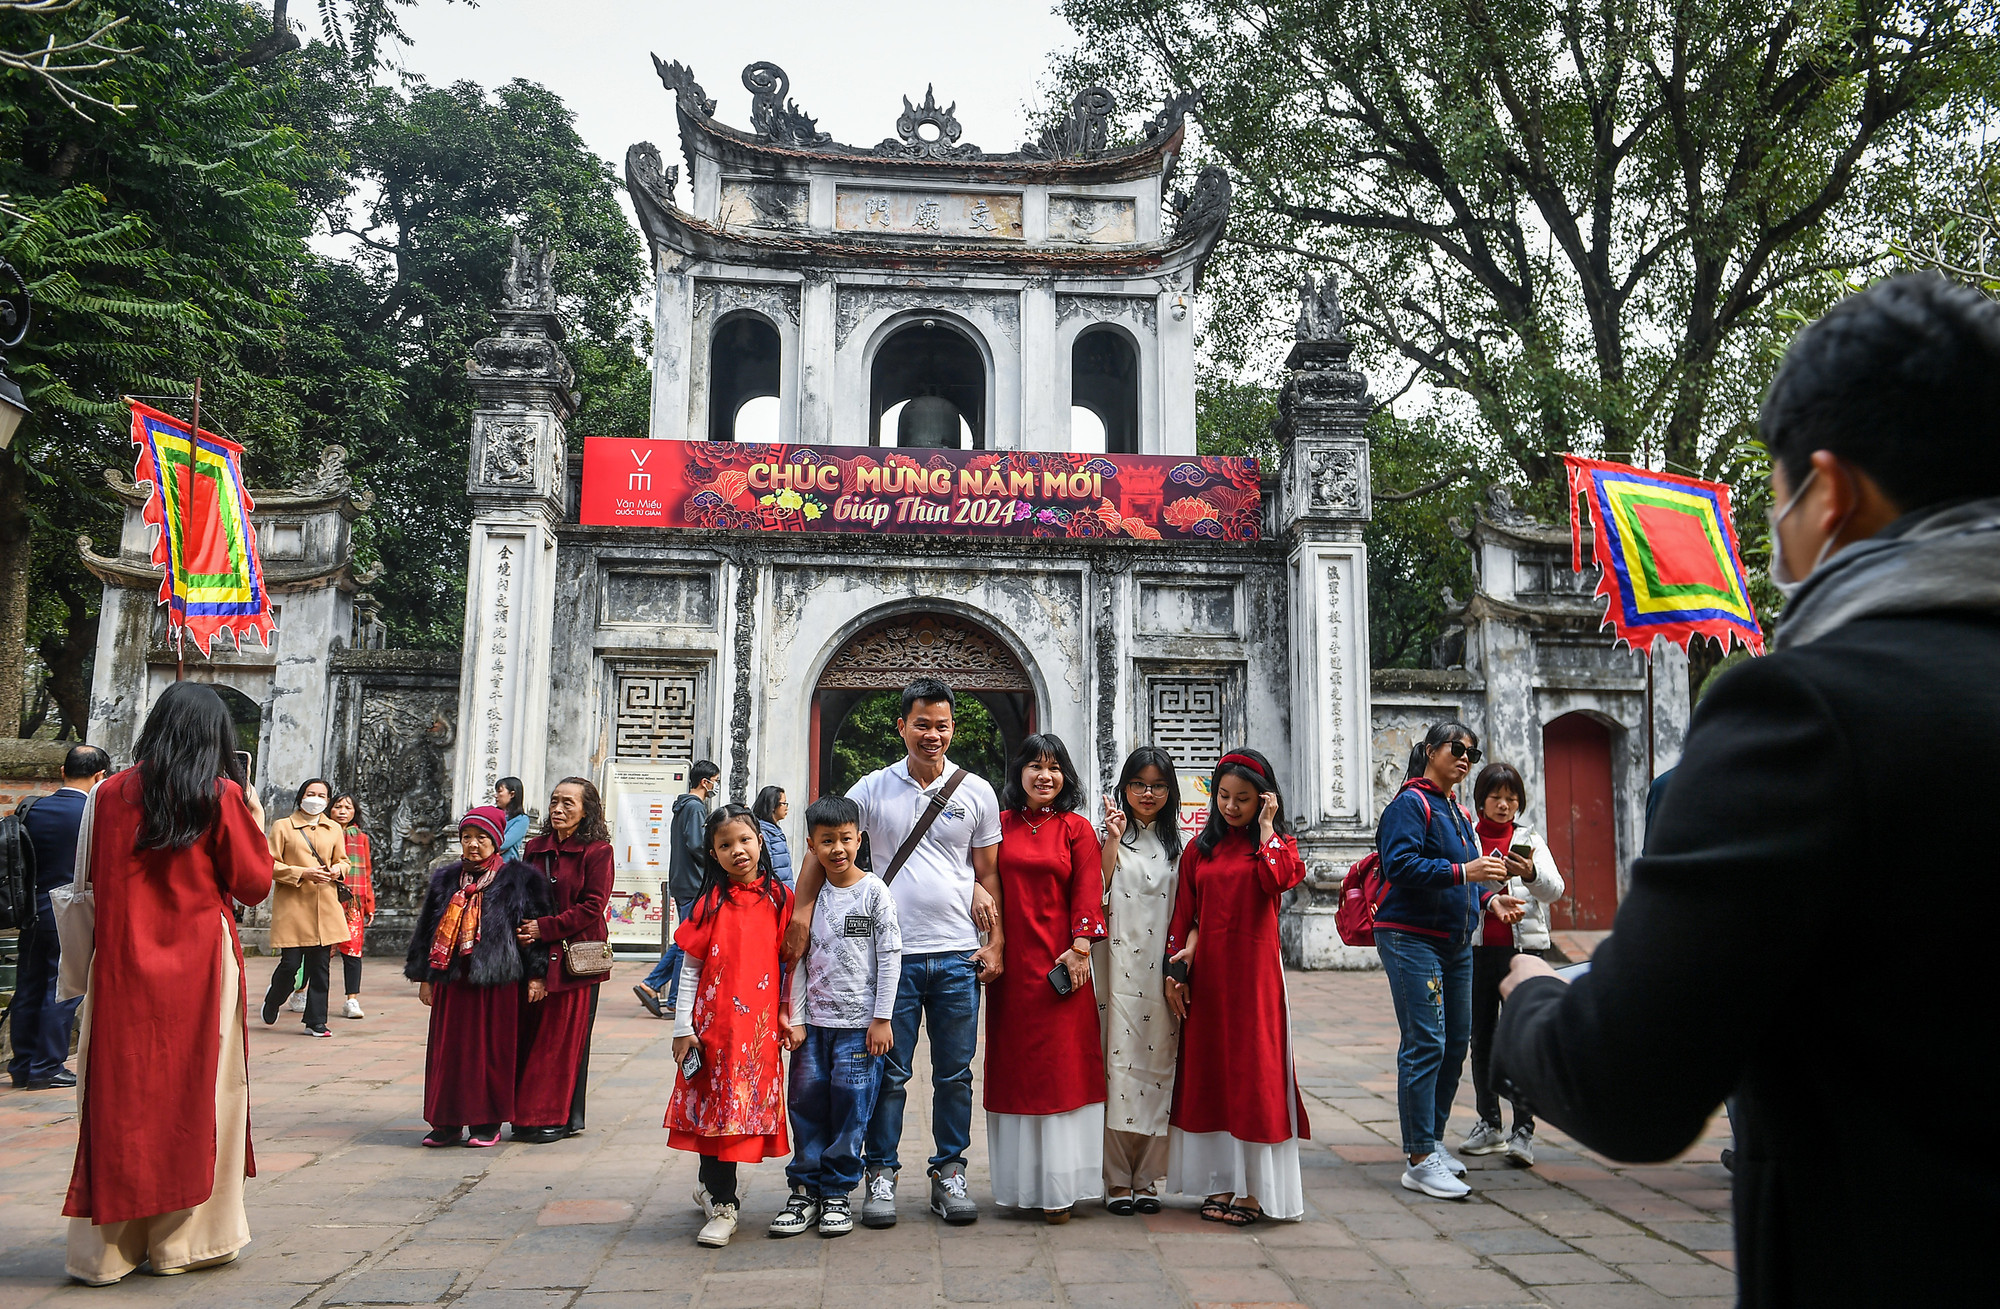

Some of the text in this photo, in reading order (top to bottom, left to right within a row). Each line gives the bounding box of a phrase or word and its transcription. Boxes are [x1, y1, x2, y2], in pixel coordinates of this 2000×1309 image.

[747, 457, 1102, 498] CHÚC MỪNG NĂM MỚI
[615, 498, 662, 510] Văn Miếu
[833, 495, 1018, 527] Giáp Thìn 2024
